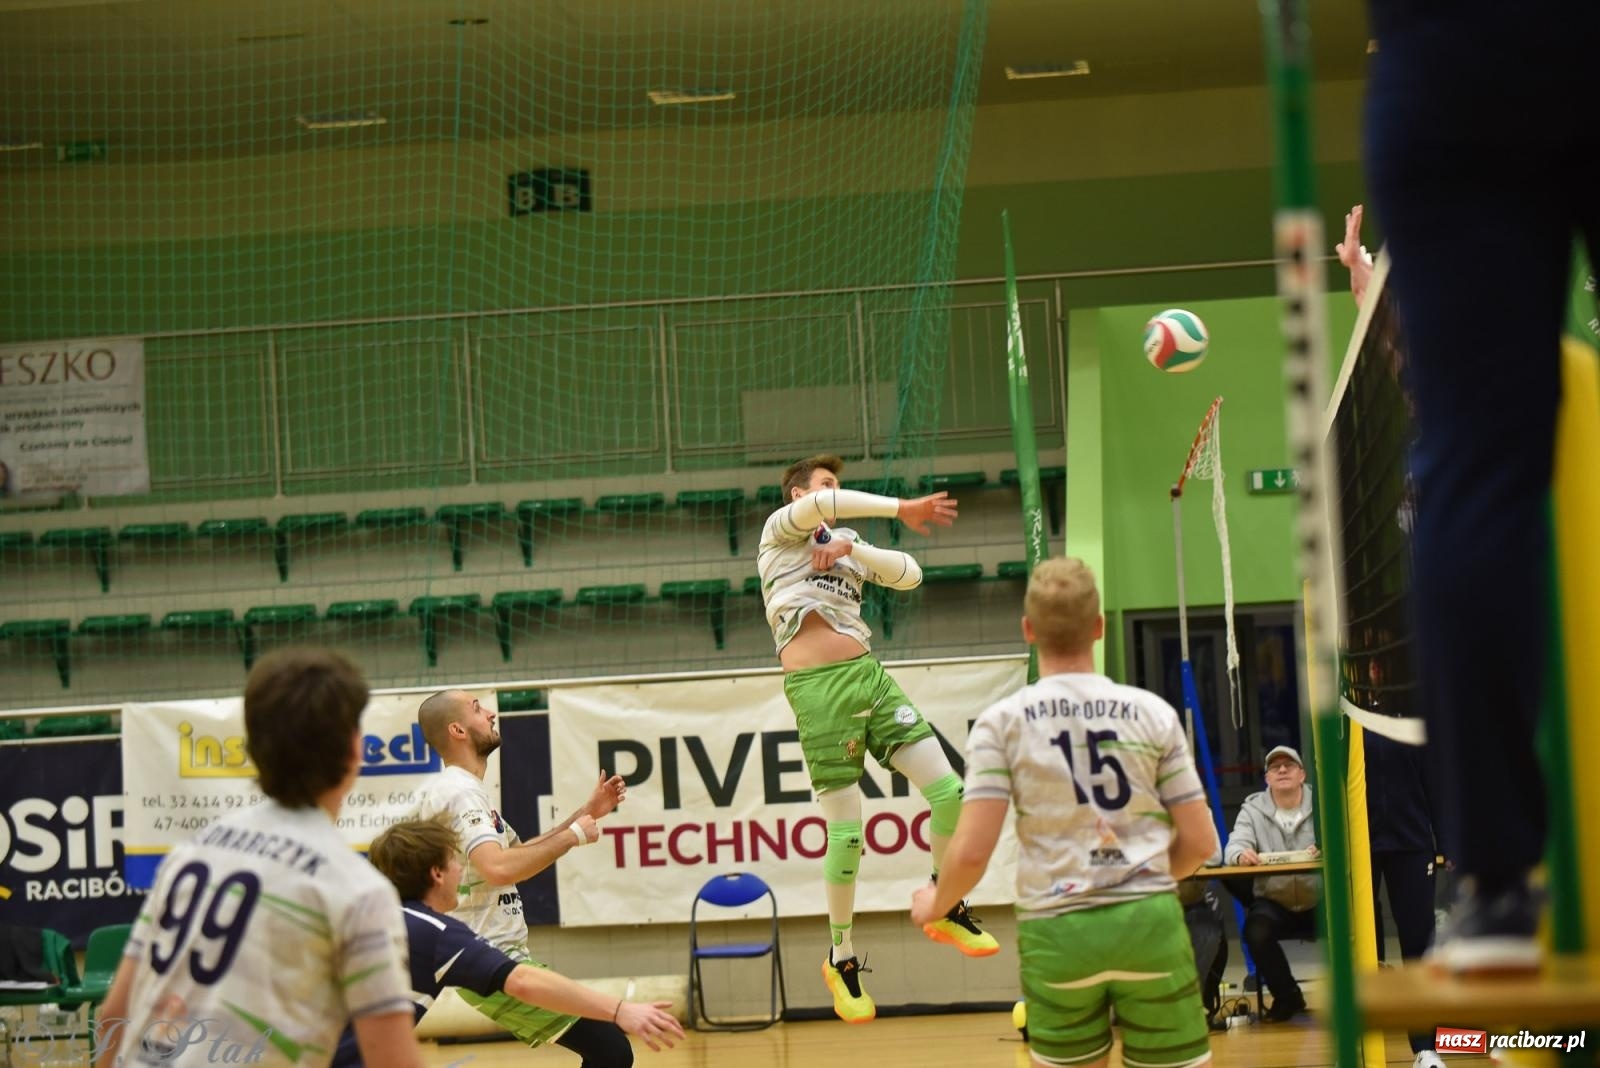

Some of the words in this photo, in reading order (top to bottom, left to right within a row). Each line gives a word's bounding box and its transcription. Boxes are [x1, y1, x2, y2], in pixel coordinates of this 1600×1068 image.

[1050, 729, 1132, 811] 15
[142, 795, 166, 808] tel.
[169, 795, 187, 808] 32
[191, 795, 220, 808] 414
[224, 795, 244, 808] 92
[388, 792, 417, 805] 606
[153, 816, 209, 830] 47-400
[361, 813, 421, 828] Eichend
[602, 810, 931, 869] TECHNOO
[151, 861, 262, 987] 99
